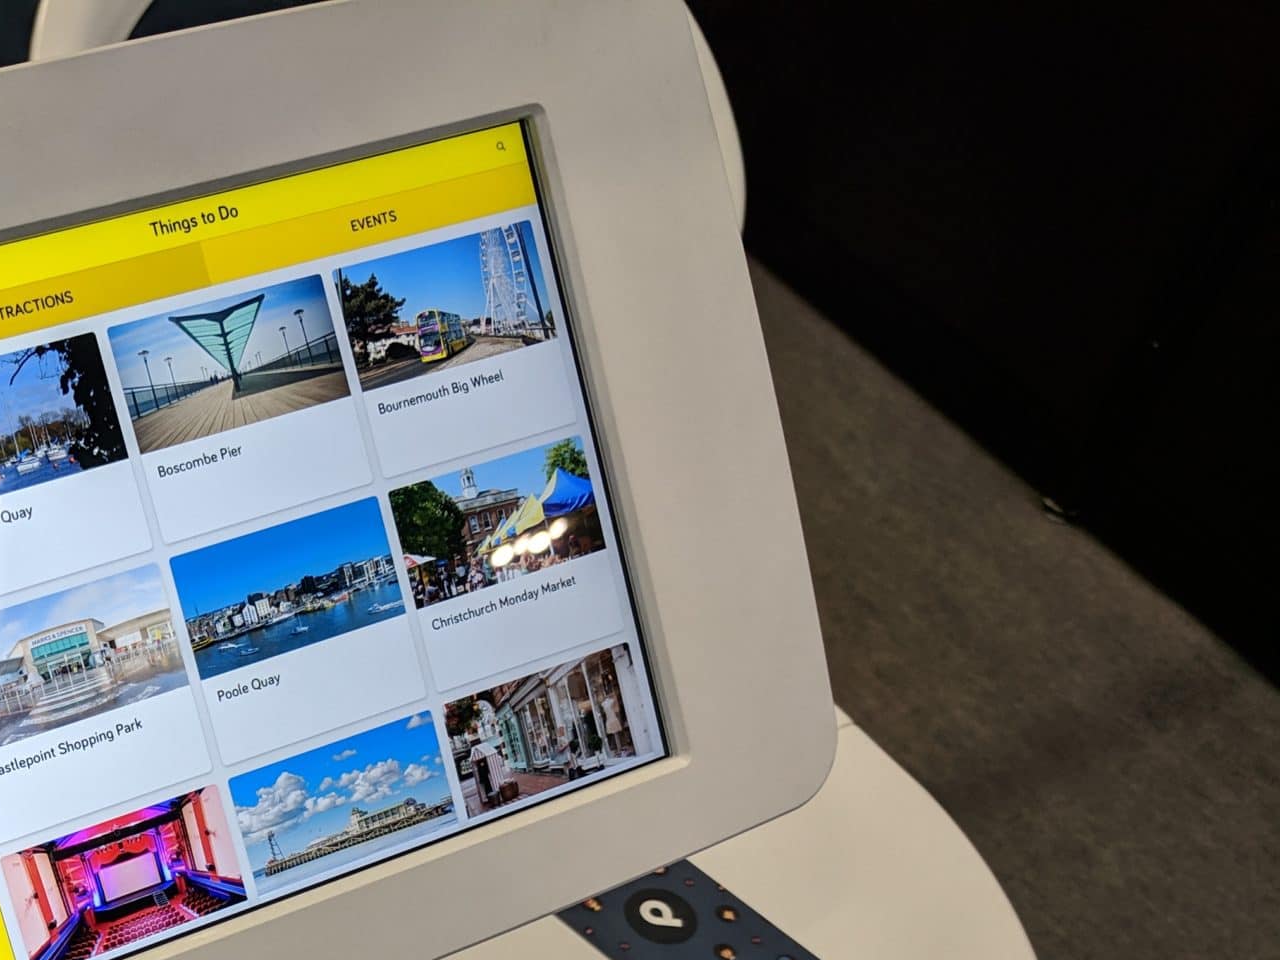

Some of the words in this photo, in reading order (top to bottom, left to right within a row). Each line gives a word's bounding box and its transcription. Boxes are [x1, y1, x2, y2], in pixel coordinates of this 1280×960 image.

[148, 214, 198, 238] Things
[200, 209, 215, 225] to
[217, 203, 238, 221] Do
[349, 209, 397, 232] EVENTS
[376, 384, 449, 415] Bournemouth
[450, 378, 469, 397] Big
[470, 369, 504, 389] Wheel
[156, 451, 217, 478] Boscombe
[218, 444, 242, 463] Pier
[0, 505, 33, 526] Quay
[430, 601, 497, 631] Christchurch
[498, 588, 539, 610] Monday
[540, 575, 576, 595] Market
[216, 679, 249, 702] Poole
[250, 672, 281, 693] Quay
[57, 730, 114, 758] Shopping
[115, 718, 143, 740] Park
